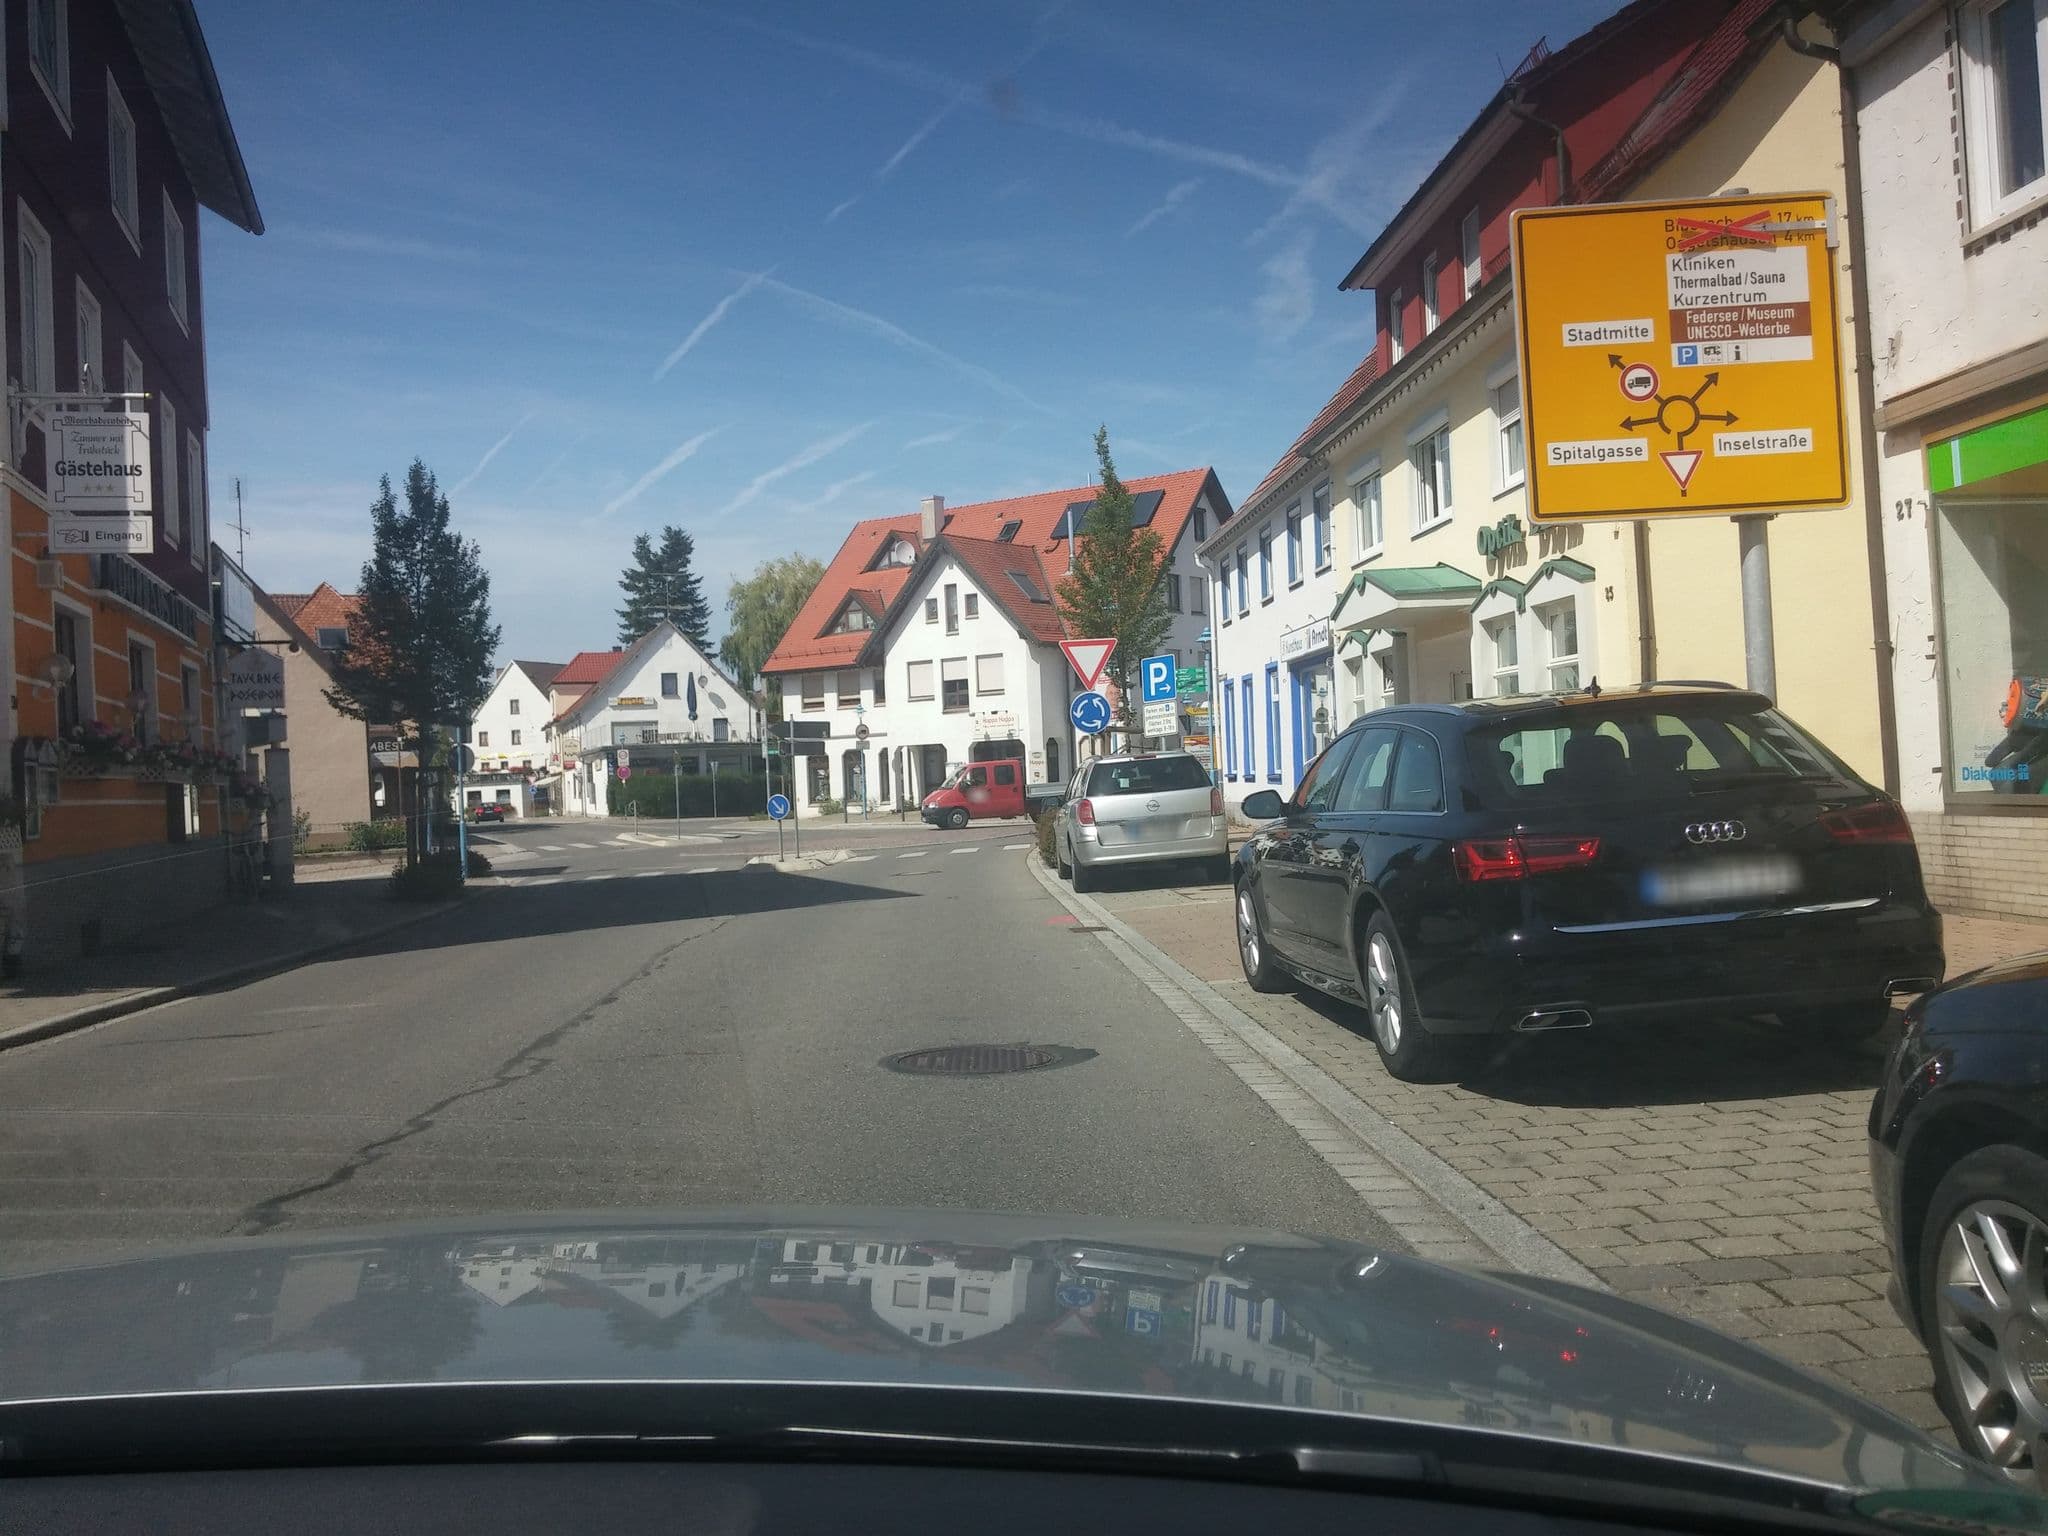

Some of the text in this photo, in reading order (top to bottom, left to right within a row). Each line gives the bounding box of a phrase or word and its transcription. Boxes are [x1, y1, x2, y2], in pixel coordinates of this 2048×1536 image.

[1777, 211, 1792, 223] 17
[1784, 231, 1793, 242] 4
[1796, 230, 1816, 242] km
[1672, 257, 1736, 272] Kliniken
[1673, 272, 1742, 289] Thermalbad
[1750, 271, 1786, 285] Sauna
[1673, 291, 1767, 306] Kurzentrum
[1686, 310, 1739, 324] Federsee
[1746, 307, 1795, 321] Museum
[1567, 325, 1650, 343] Stadtmitte
[1686, 321, 1791, 340] UNESCO-Welterbe
[1717, 433, 1808, 452] Inselstraße
[1551, 444, 1644, 463] Spitalgasse
[55, 460, 143, 477] Gästehaus
[1894, 497, 1913, 522] 27
[95, 530, 143, 542] Eingang
[1149, 662, 1168, 697] P
[370, 741, 405, 752] ABEST
[1961, 766, 2016, 781] Diakonie
